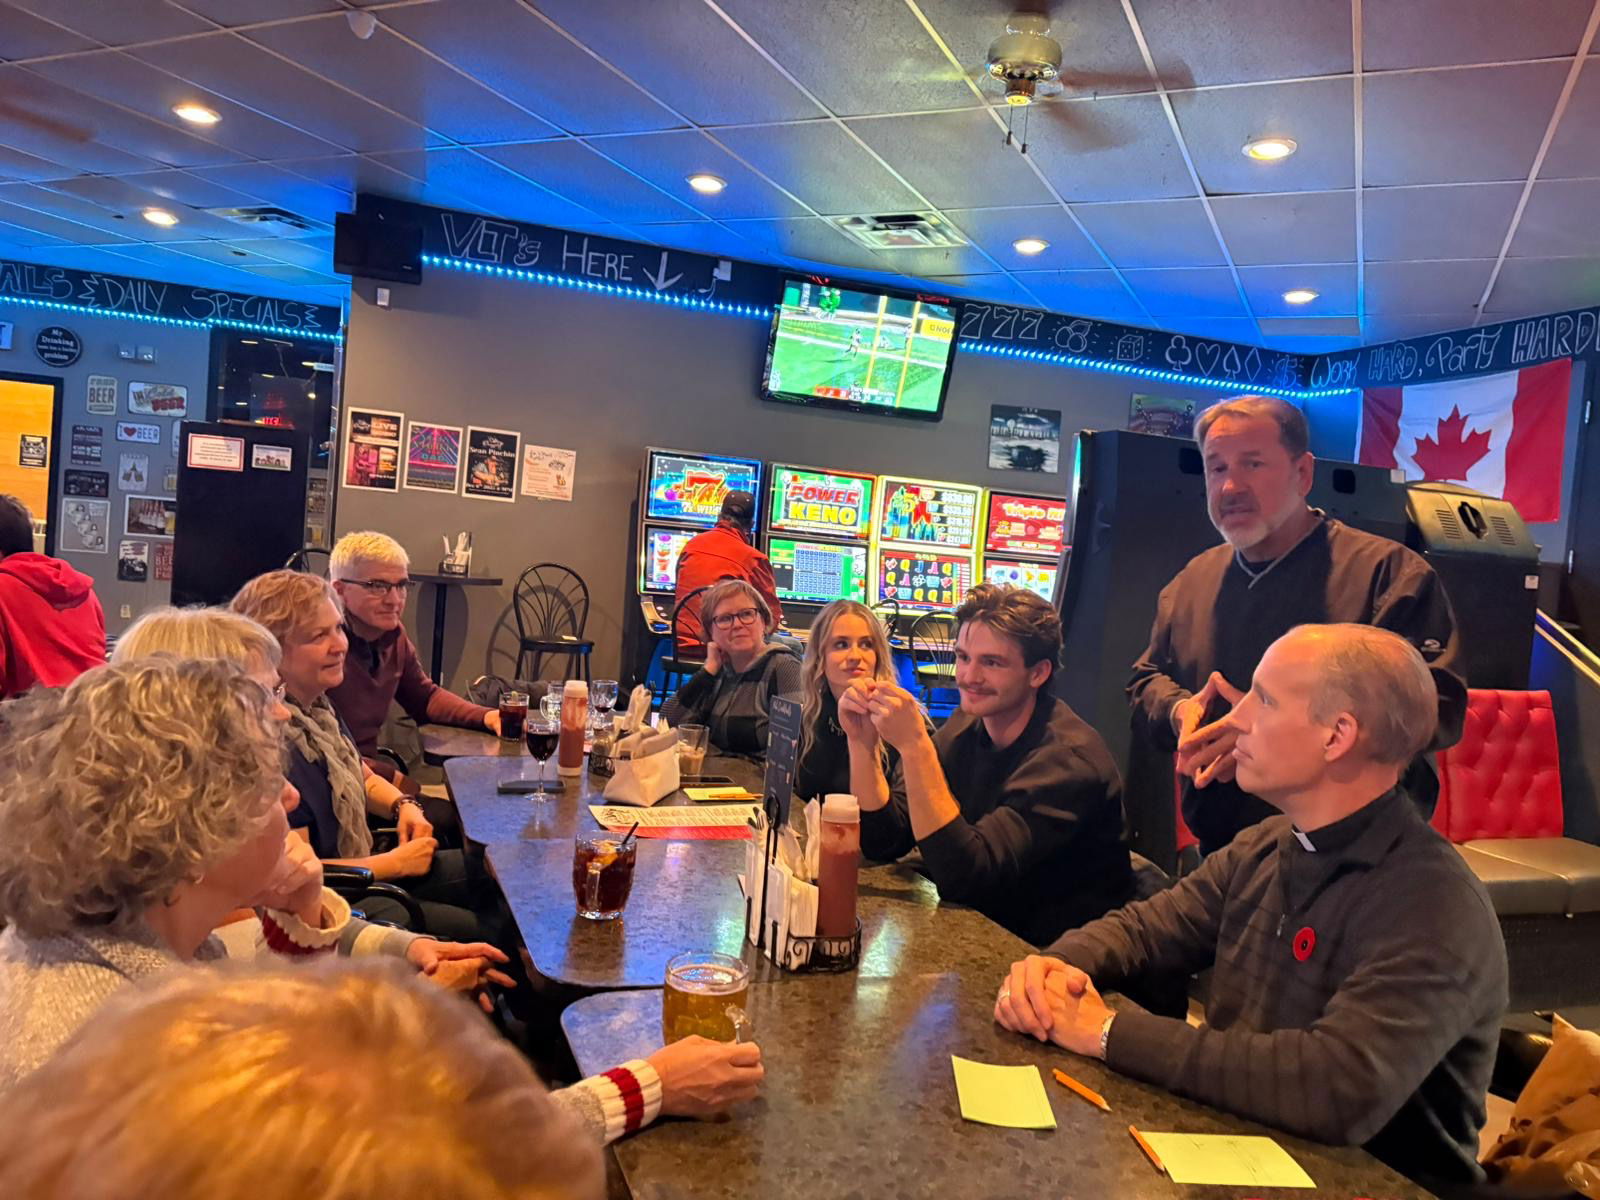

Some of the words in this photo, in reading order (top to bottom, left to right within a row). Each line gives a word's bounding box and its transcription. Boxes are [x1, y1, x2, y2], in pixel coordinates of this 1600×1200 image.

[562, 234, 634, 282] HERE
[103, 278, 168, 316] DAILY
[183, 288, 301, 329] SPECIALS
[89, 387, 116, 405] BEER
[136, 427, 159, 440] BEER
[787, 484, 860, 505] POWER
[789, 501, 857, 525] KENO
